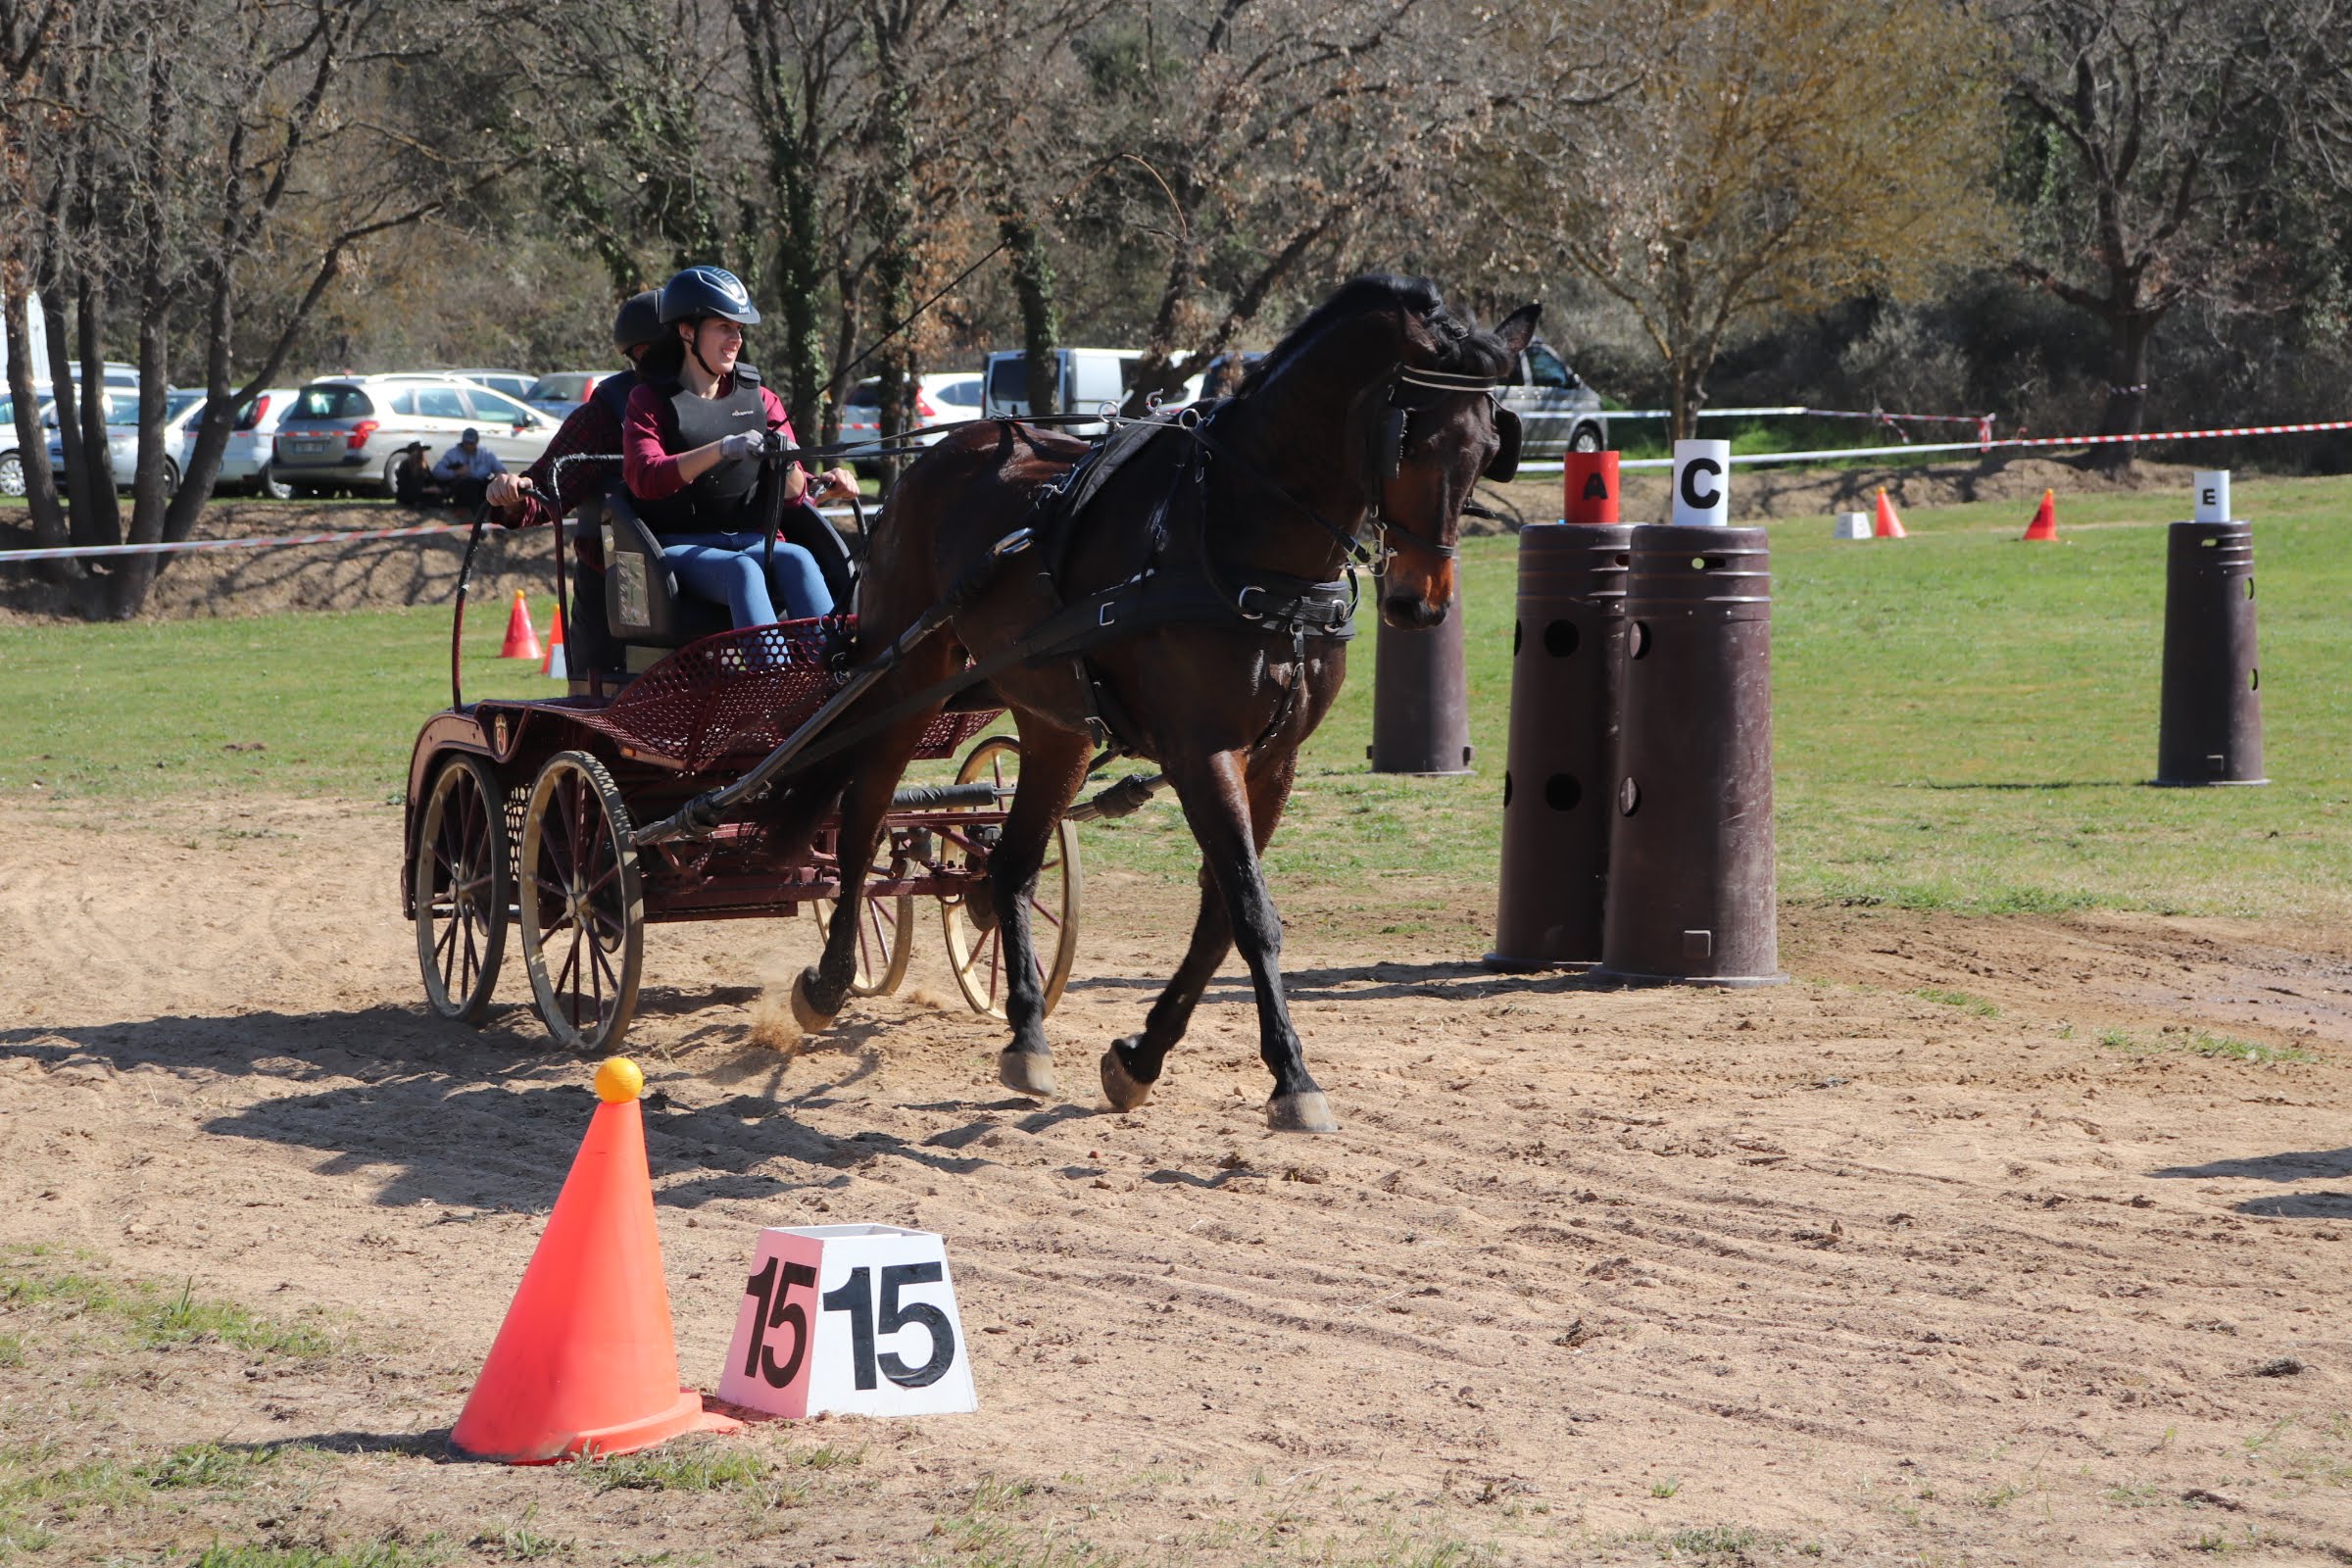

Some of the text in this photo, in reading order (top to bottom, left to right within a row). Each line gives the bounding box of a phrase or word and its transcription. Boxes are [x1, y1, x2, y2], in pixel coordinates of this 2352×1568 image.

[1583, 472, 1608, 501] A
[1681, 458, 1722, 510] C
[2202, 488, 2217, 506] E
[744, 1255, 817, 1390] 15
[822, 1260, 956, 1392] 15
